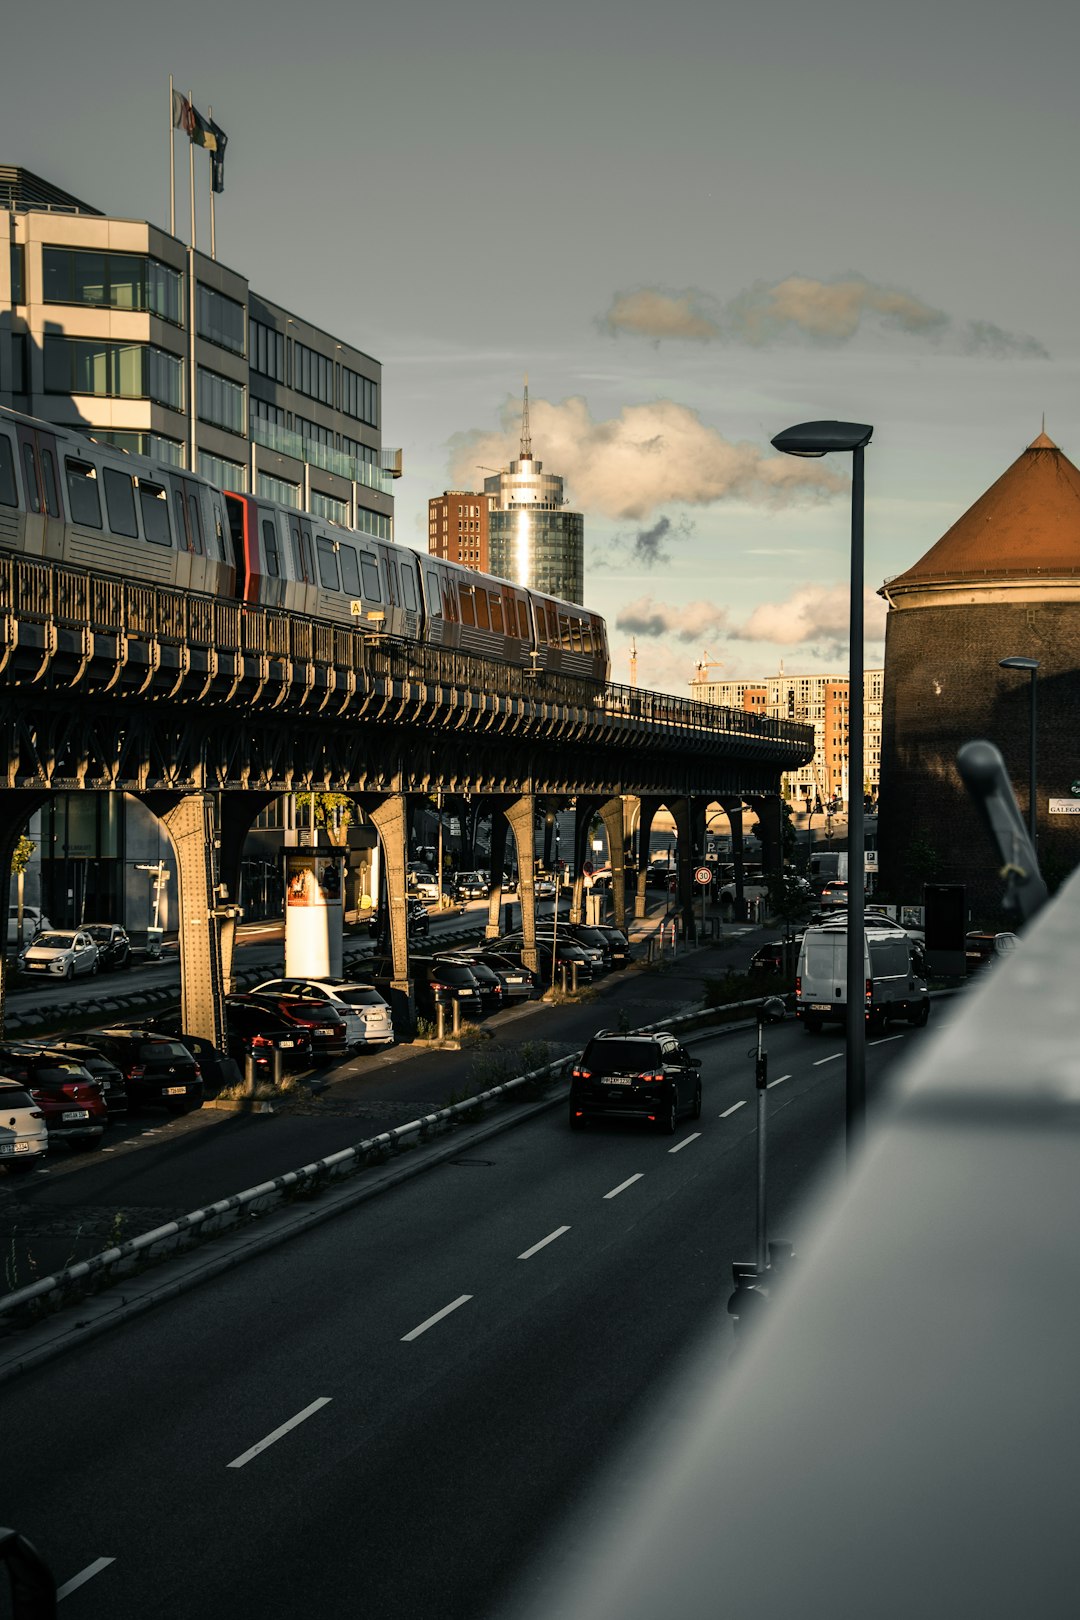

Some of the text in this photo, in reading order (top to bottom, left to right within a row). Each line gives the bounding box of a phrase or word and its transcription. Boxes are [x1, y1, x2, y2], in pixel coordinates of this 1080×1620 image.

[352, 603, 360, 613] A
[707, 842, 715, 852] P
[699, 872, 709, 880] 30
